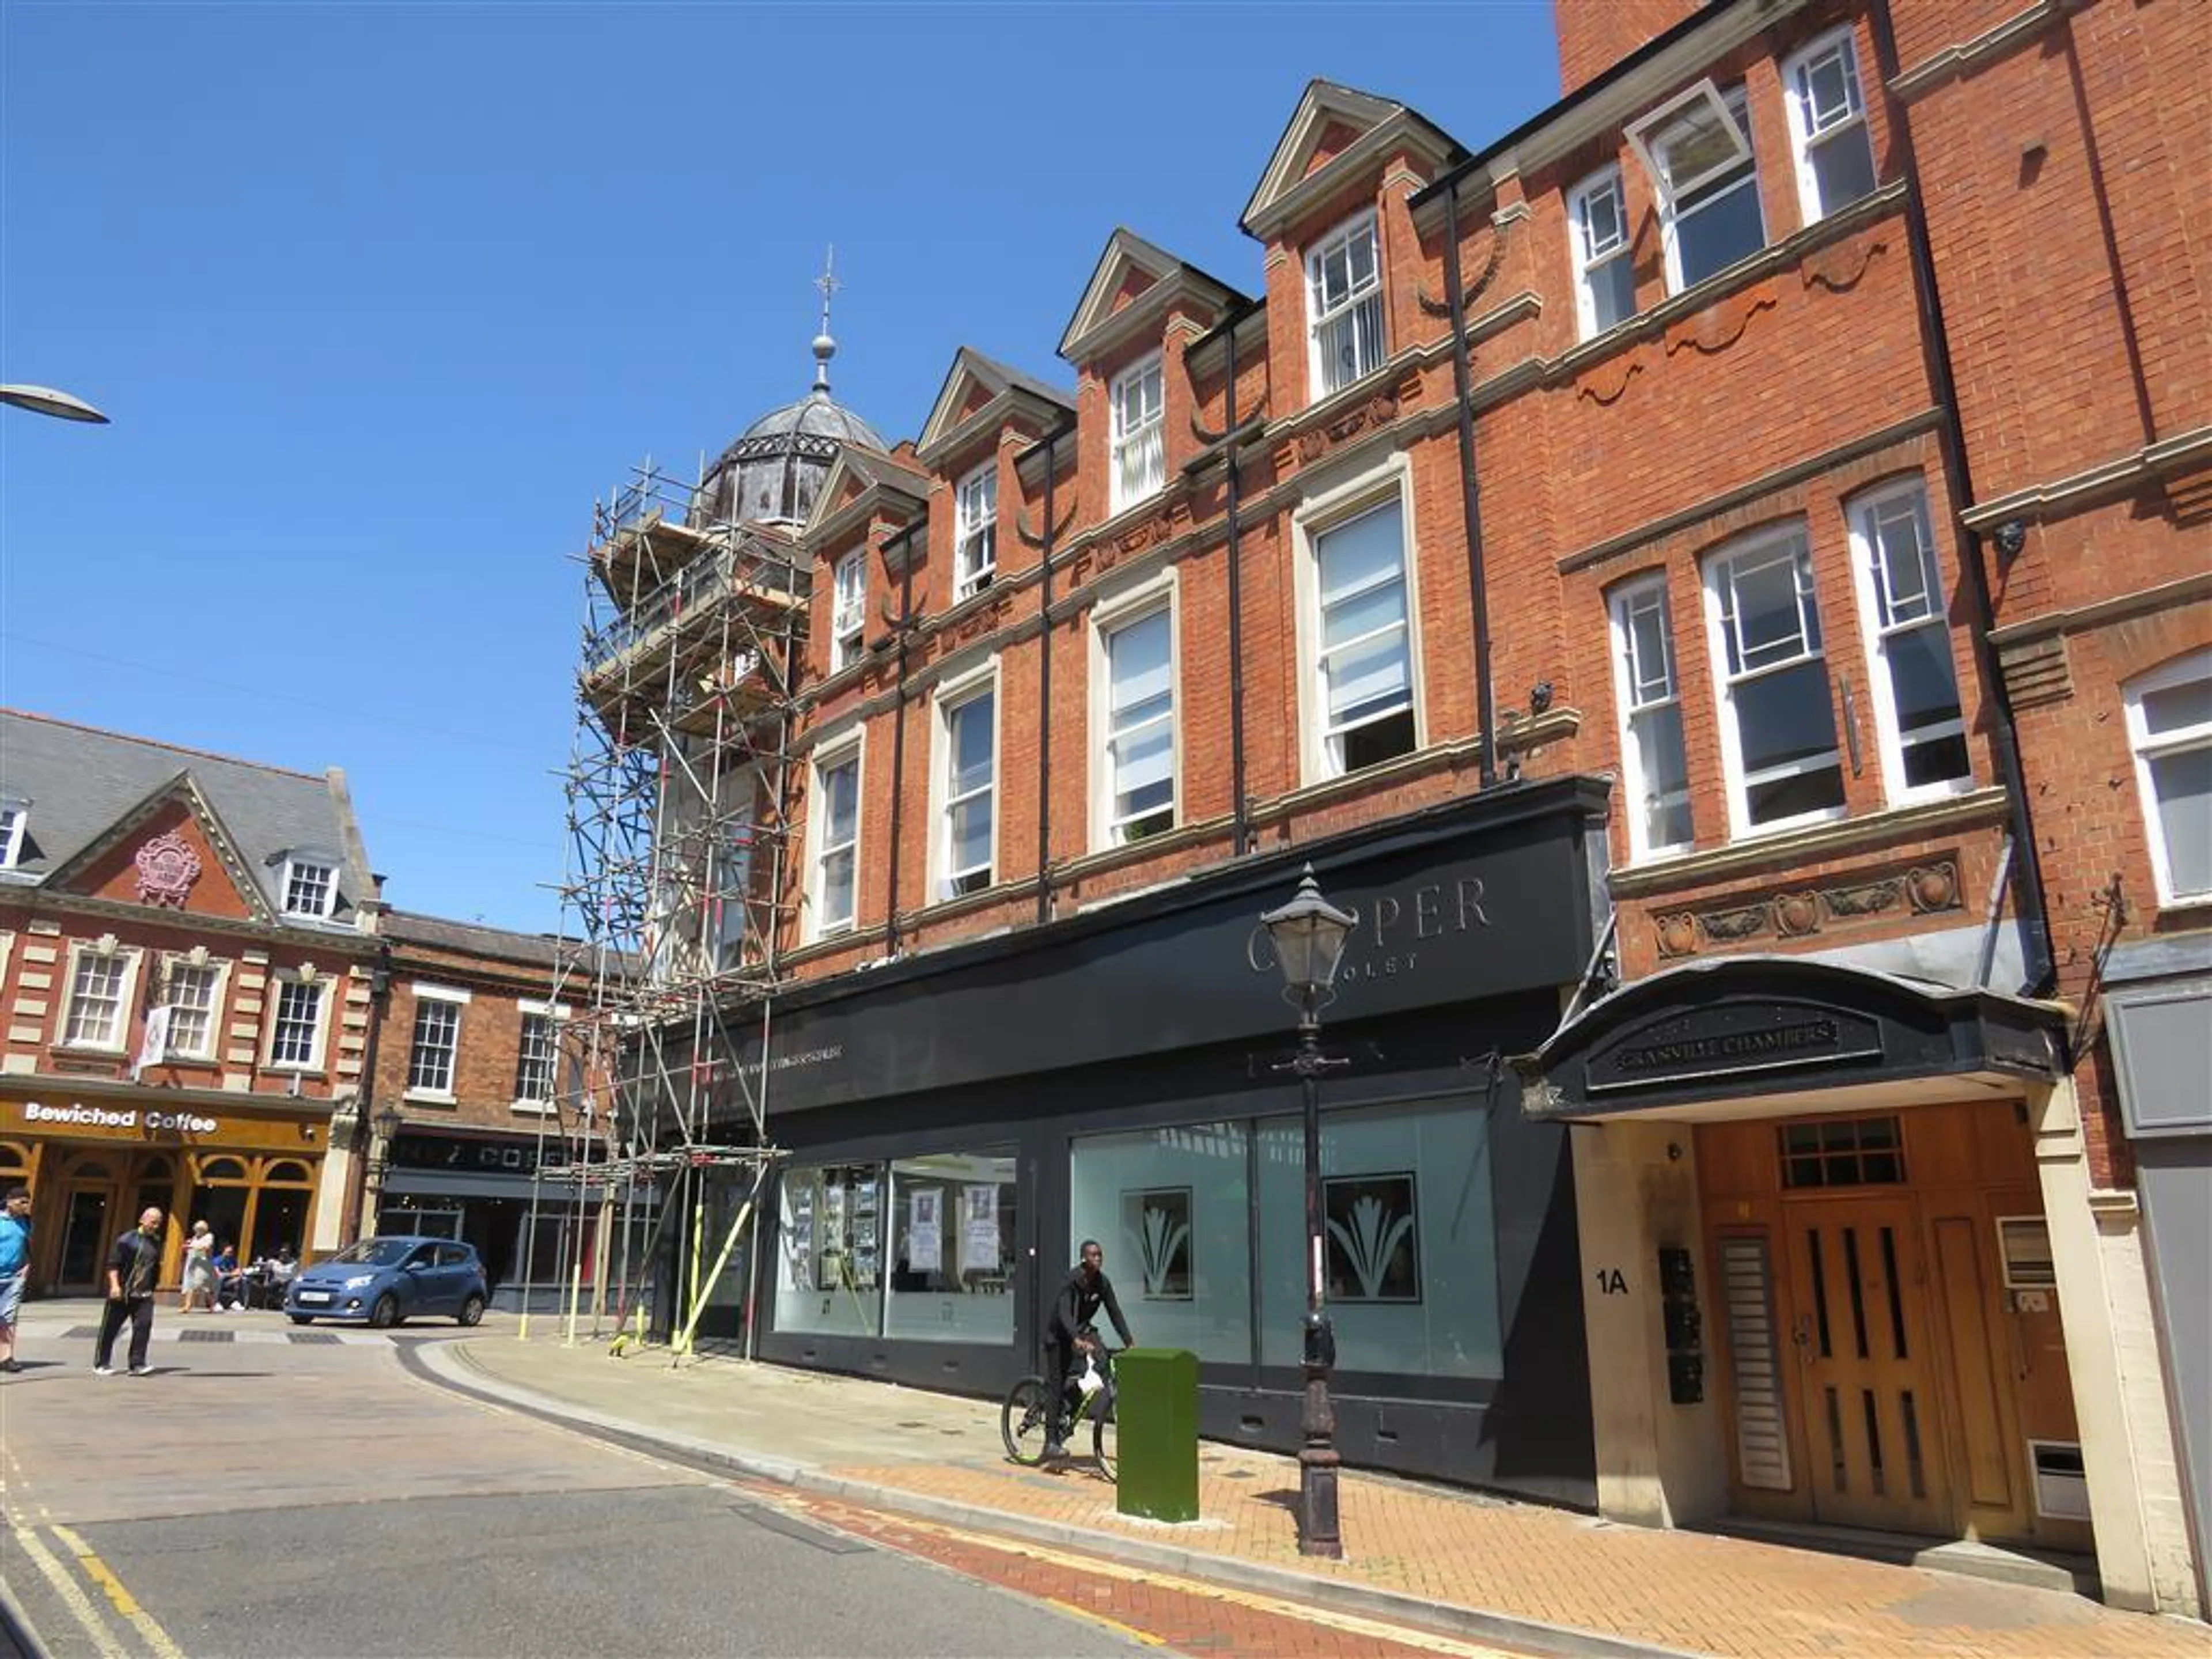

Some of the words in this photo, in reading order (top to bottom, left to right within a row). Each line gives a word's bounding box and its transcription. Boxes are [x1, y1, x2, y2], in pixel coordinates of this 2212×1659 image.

[1247, 877, 1491, 972] CPER
[25, 1101, 136, 1127] Bewiched
[146, 1111, 218, 1132] Coffee
[1596, 1268, 1628, 1295] 1A
